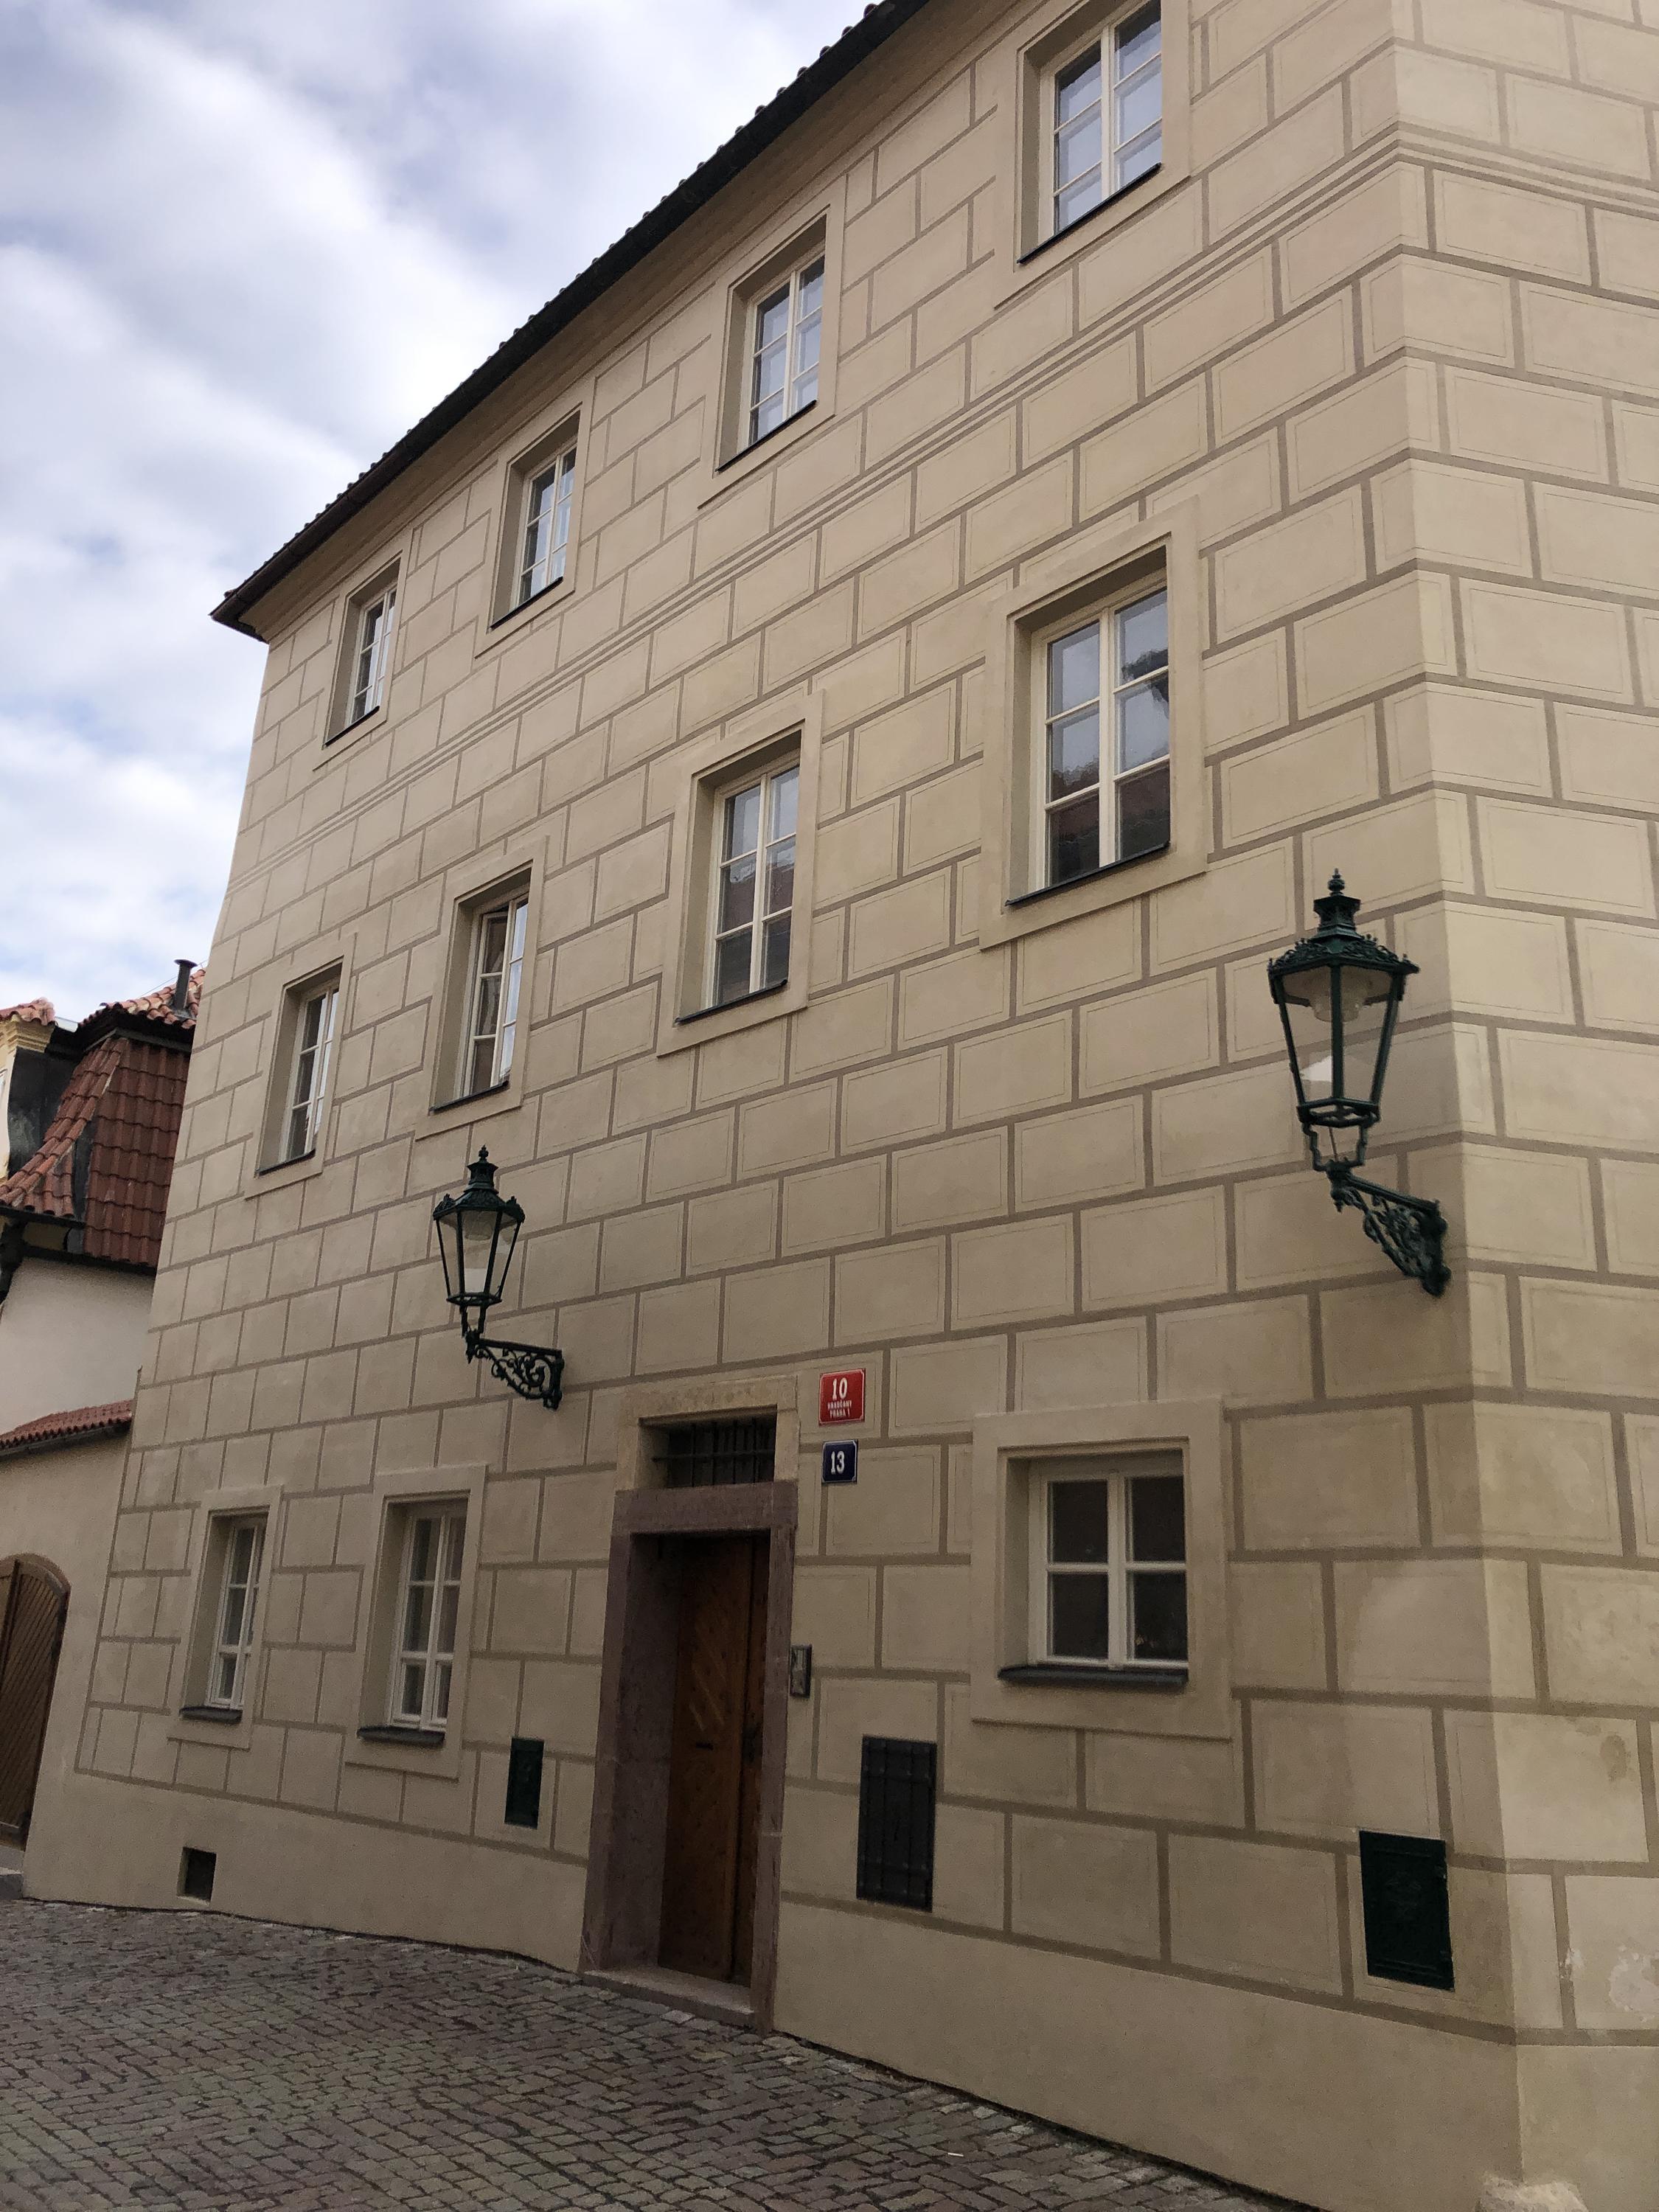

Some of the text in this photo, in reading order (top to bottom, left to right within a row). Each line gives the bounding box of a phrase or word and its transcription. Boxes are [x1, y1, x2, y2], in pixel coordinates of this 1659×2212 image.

[832, 1377, 848, 1400] 10
[830, 1408, 846, 1419] PRAHA
[831, 1450, 845, 1475] 13
